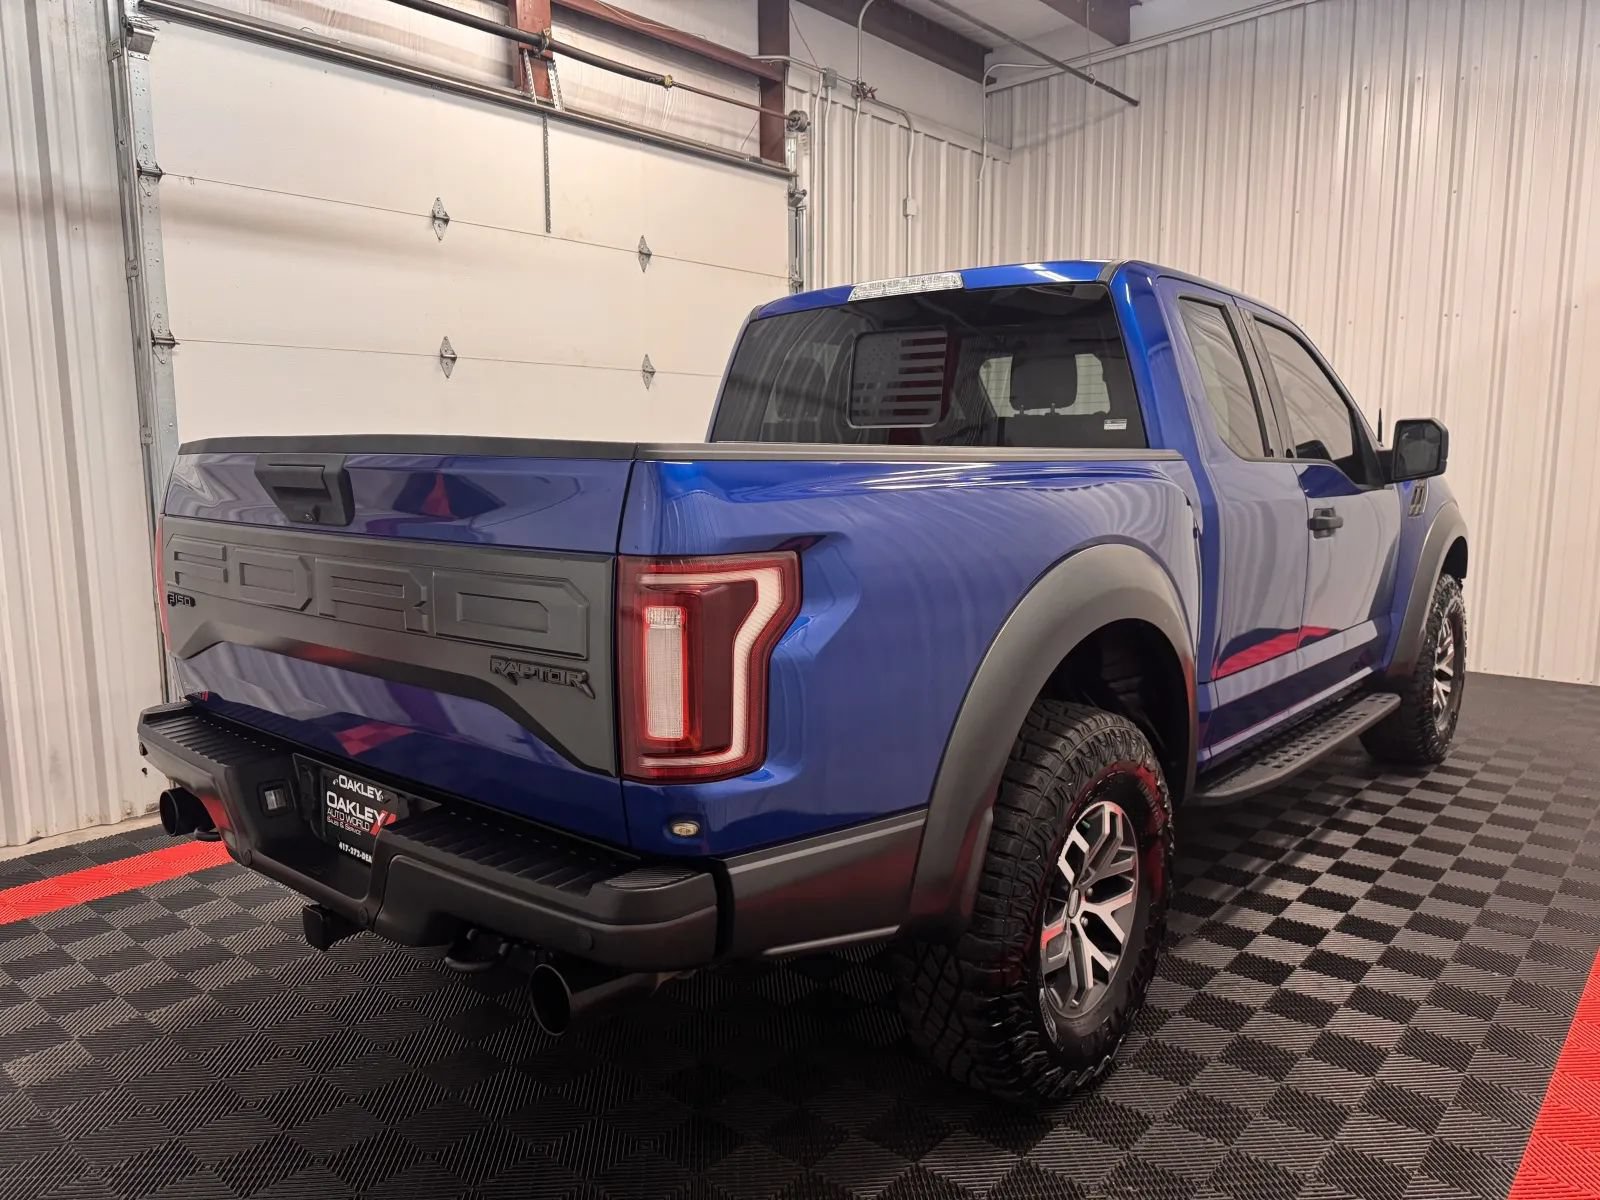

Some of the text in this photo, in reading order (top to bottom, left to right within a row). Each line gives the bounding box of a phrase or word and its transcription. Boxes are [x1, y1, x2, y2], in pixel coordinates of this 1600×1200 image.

[165, 534, 589, 659] FORD
[490, 655, 594, 697] RAPTOR
[339, 774, 382, 801] OAKLEY
[326, 791, 387, 827] OAKLEY
[327, 808, 371, 832] AUTO WORLD
